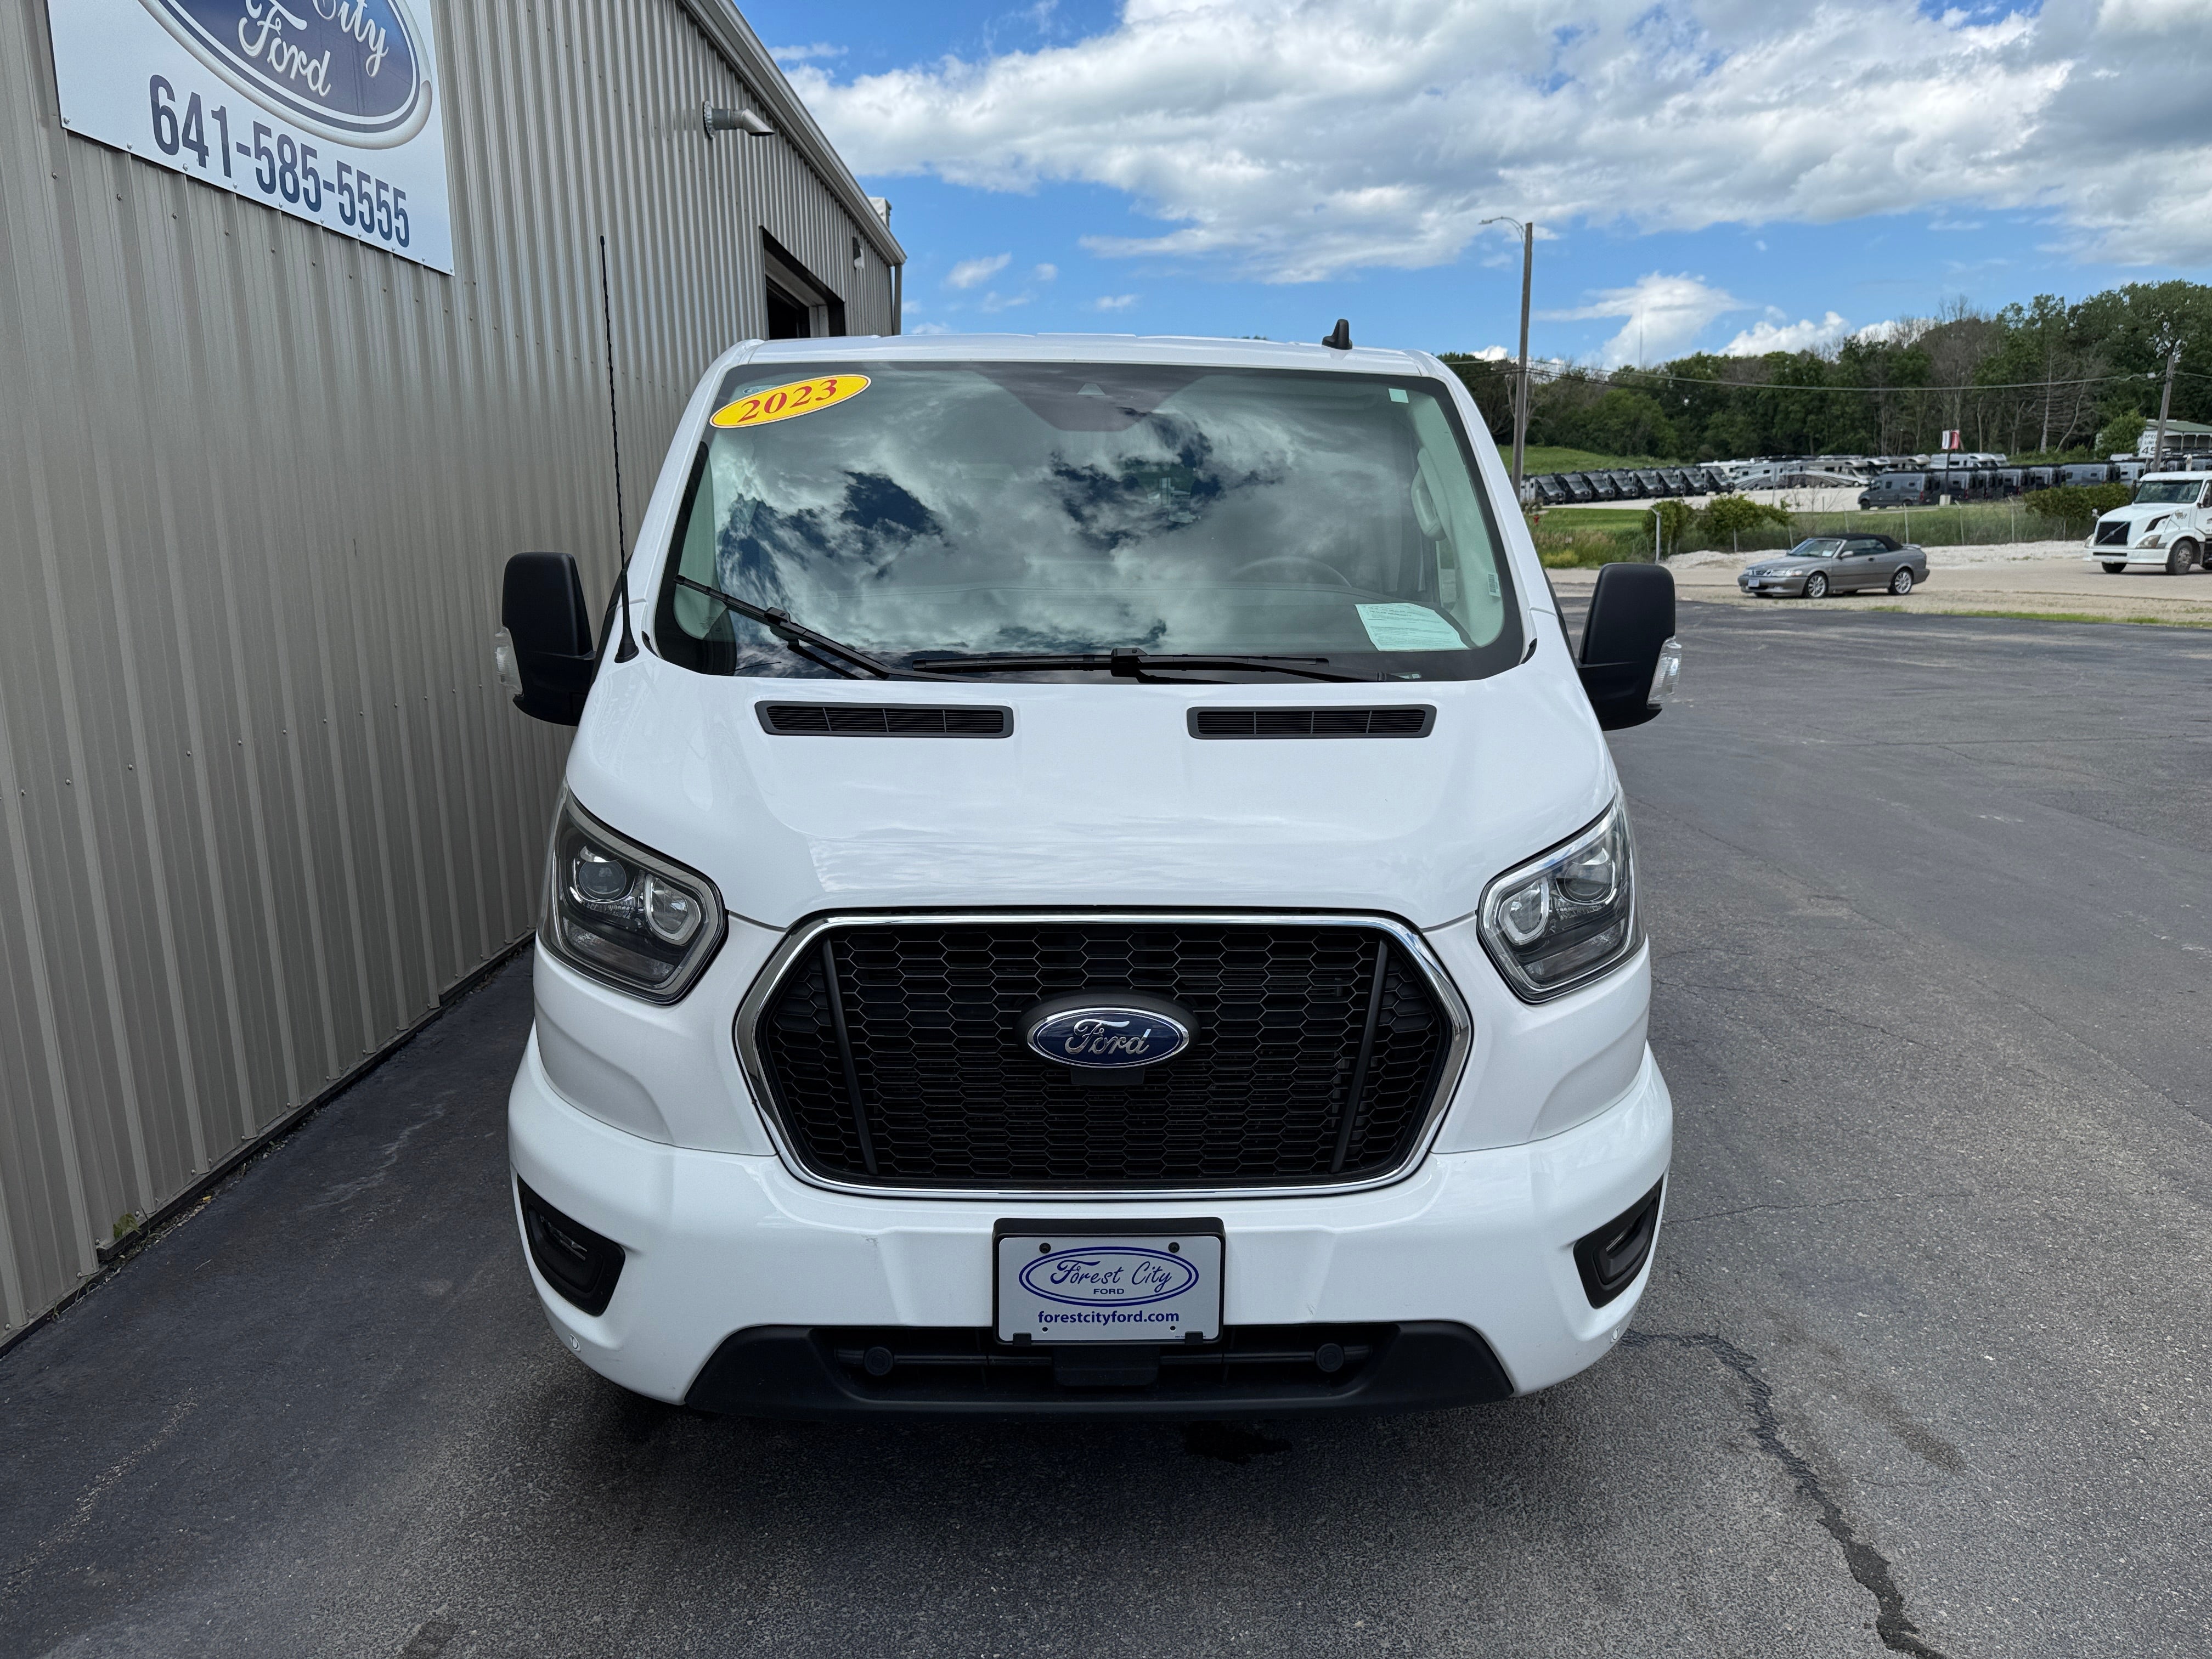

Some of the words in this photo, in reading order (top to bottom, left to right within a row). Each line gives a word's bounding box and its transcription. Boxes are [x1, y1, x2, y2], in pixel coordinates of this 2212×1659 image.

[238, 0, 331, 97] Ford
[149, 74, 410, 248] 641-585-5555
[736, 379, 838, 424] 2023
[1064, 1019, 1152, 1055] Ford
[1050, 1260, 1124, 1284] Forest
[1131, 1261, 1172, 1293] City
[1037, 1310, 1180, 1326] forestcityford.com
